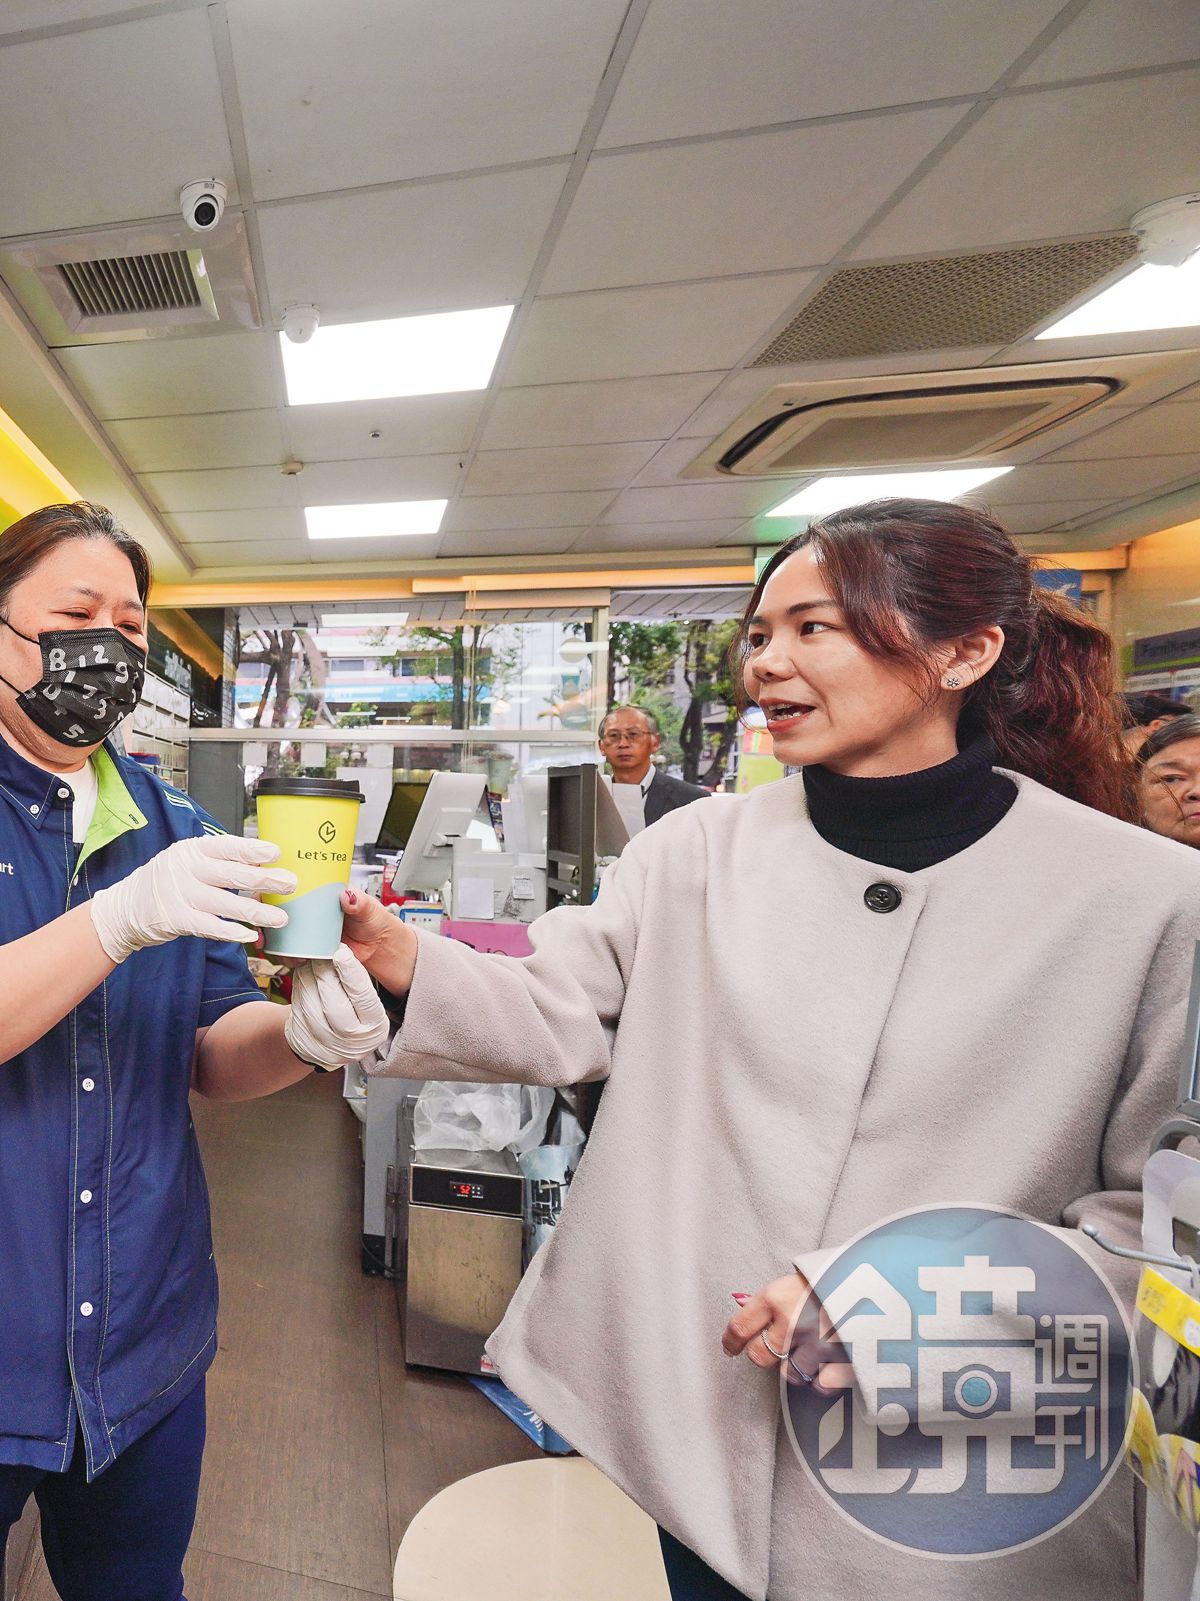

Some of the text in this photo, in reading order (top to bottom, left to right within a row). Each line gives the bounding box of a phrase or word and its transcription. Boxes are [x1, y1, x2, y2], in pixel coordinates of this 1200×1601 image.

[49, 648, 66, 671] 8
[93, 645, 108, 664] 2
[115, 661, 129, 684] 9
[93, 699, 107, 719] 3
[297, 850, 347, 862] Let's Tea
